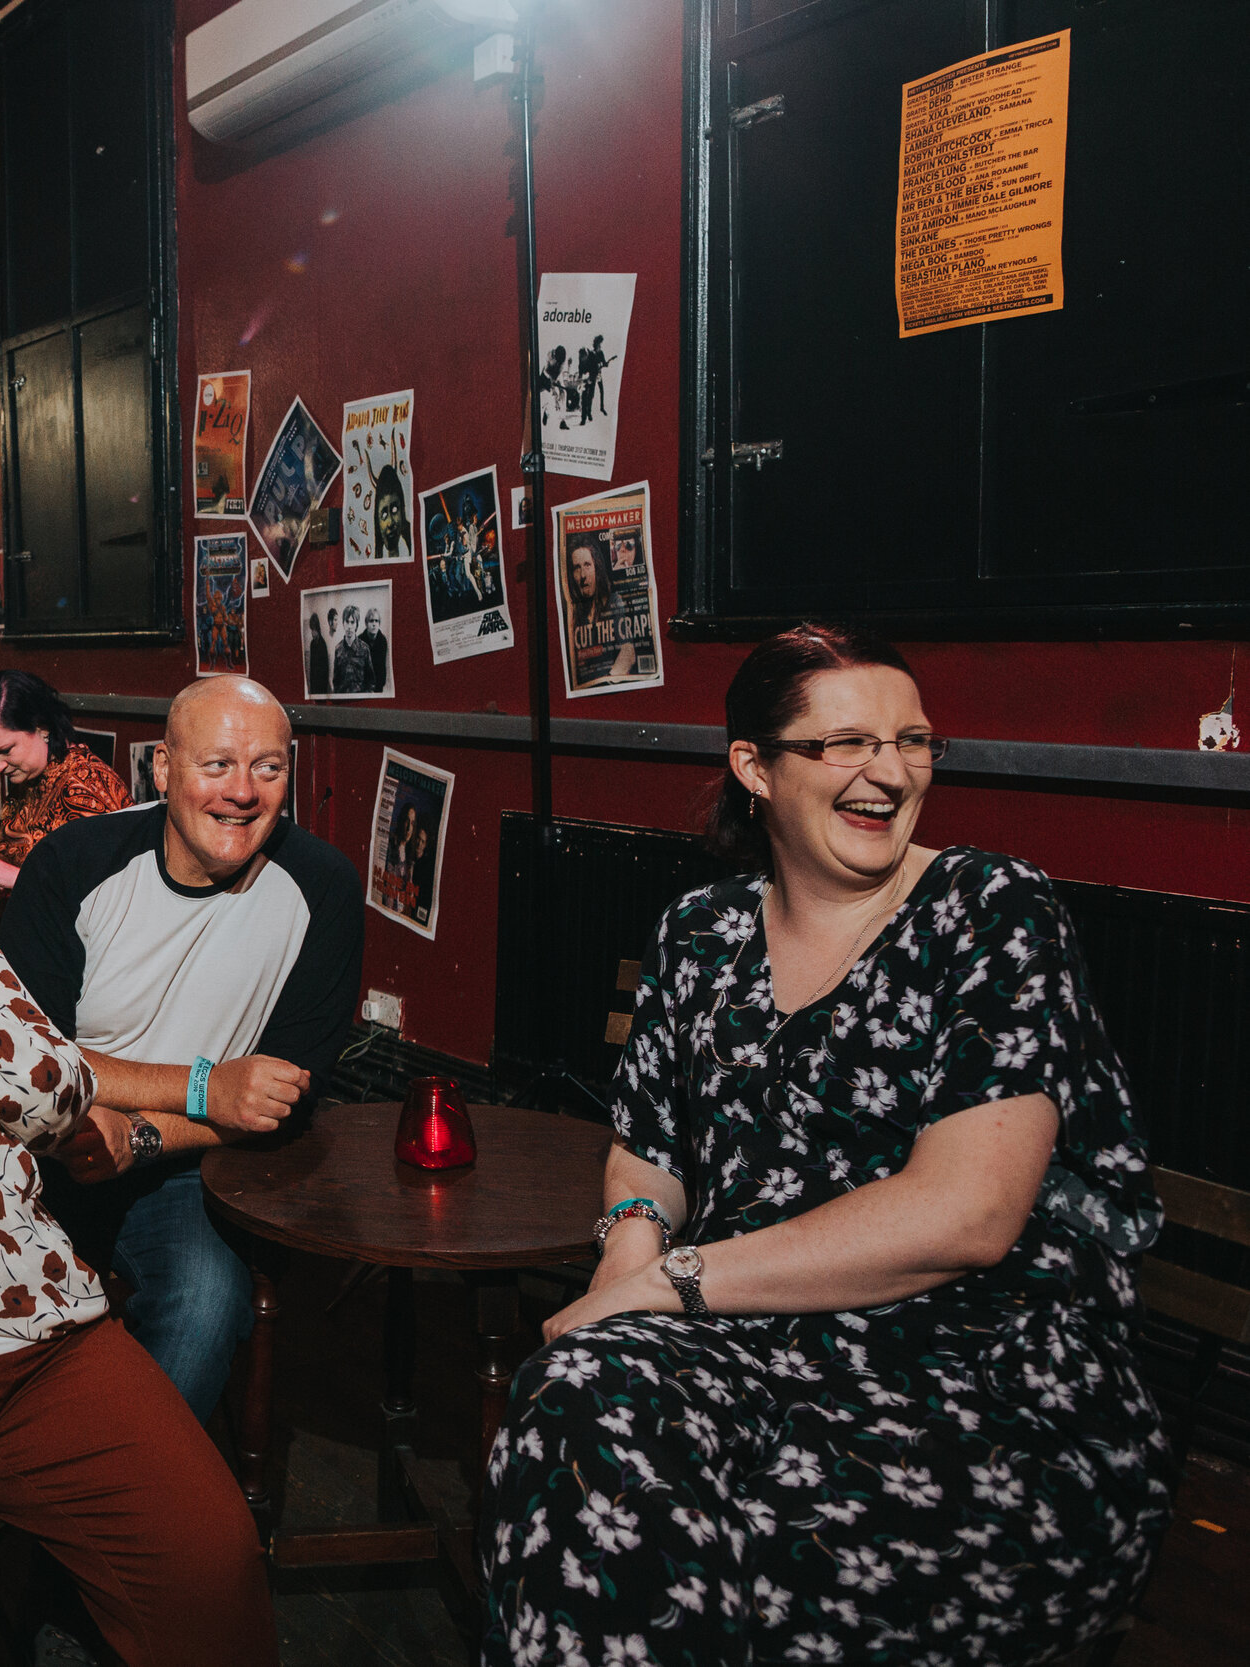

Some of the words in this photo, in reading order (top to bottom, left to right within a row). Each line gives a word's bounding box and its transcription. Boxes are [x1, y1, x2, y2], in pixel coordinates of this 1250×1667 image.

[929, 80, 953, 97] DUMB
[960, 72, 983, 84] MISTER
[986, 60, 1021, 76] STRANGE
[957, 60, 986, 76] PRESENTS
[928, 107, 948, 121] XIXA
[955, 100, 975, 112] JONNY
[978, 87, 1021, 104] WOODHEAD
[929, 93, 951, 109] DEHD
[905, 124, 933, 142] SHANA
[936, 105, 990, 130] CLEVELAND
[998, 97, 1031, 111] SAMANA
[904, 148, 933, 165] ROBYN
[936, 131, 991, 155] HITCHCOCK
[999, 125, 1022, 137] EMMA
[1025, 117, 1052, 130] TRICCA
[904, 133, 942, 153] LAMBERT
[903, 159, 935, 177] MARTIN
[937, 142, 994, 166] KOHLSTEDT
[903, 170, 938, 189] FRANCIS
[942, 162, 966, 177] LUNG
[974, 155, 1005, 168] BUTCHER
[1008, 151, 1021, 159] THE
[1023, 147, 1038, 156] BAR
[902, 185, 931, 201] WEYES
[935, 175, 965, 191] BLOOD
[974, 172, 989, 181] ANA
[992, 162, 1028, 176] ROXANNE
[902, 202, 914, 213] MR
[917, 196, 934, 208] BEN
[937, 194, 942, 203] &
[945, 189, 962, 201] THE
[965, 181, 993, 195] BENS
[1001, 178, 1016, 187] SUN
[1019, 172, 1040, 182] DRIFT
[901, 213, 919, 224] DAVE
[922, 207, 942, 219] ALVIN
[951, 197, 979, 211] JIMMIE
[982, 191, 1005, 203] DALE
[1008, 180, 1052, 197] GILMORE
[901, 224, 918, 236] SAM
[921, 214, 958, 231] AMIDON
[966, 210, 986, 219] MANO
[988, 198, 1036, 214] MCLAUGHLIN
[901, 231, 938, 248] SINKANE
[901, 249, 916, 260] THE
[919, 239, 956, 255] DELINES
[964, 234, 986, 244] THOSE
[988, 228, 1014, 239] PRETTY
[1017, 220, 1051, 233] WRONGS
[901, 259, 925, 272] MEGA
[928, 253, 947, 265] BOG
[954, 248, 984, 259] BAMBOO
[901, 265, 948, 284] SEBASTIAN
[952, 258, 985, 272] PLANO
[905, 281, 919, 289] JOHN
[921, 274, 951, 285] METCALFE
[959, 264, 995, 277] SEBASTIAN
[998, 256, 1037, 269] REYNOLDS
[984, 281, 1004, 289] ERLAND
[543, 307, 592, 323] adorable
[949, 311, 963, 319] FROM
[970, 300, 987, 308] PEGGY
[263, 434, 306, 524] PULP
[477, 621, 509, 637] WARS
[482, 609, 504, 623] STAR
[574, 624, 593, 650] CUT
[596, 619, 616, 644] THE
[618, 614, 653, 640] CRAP!
[372, 877, 417, 908] HEAVEN
